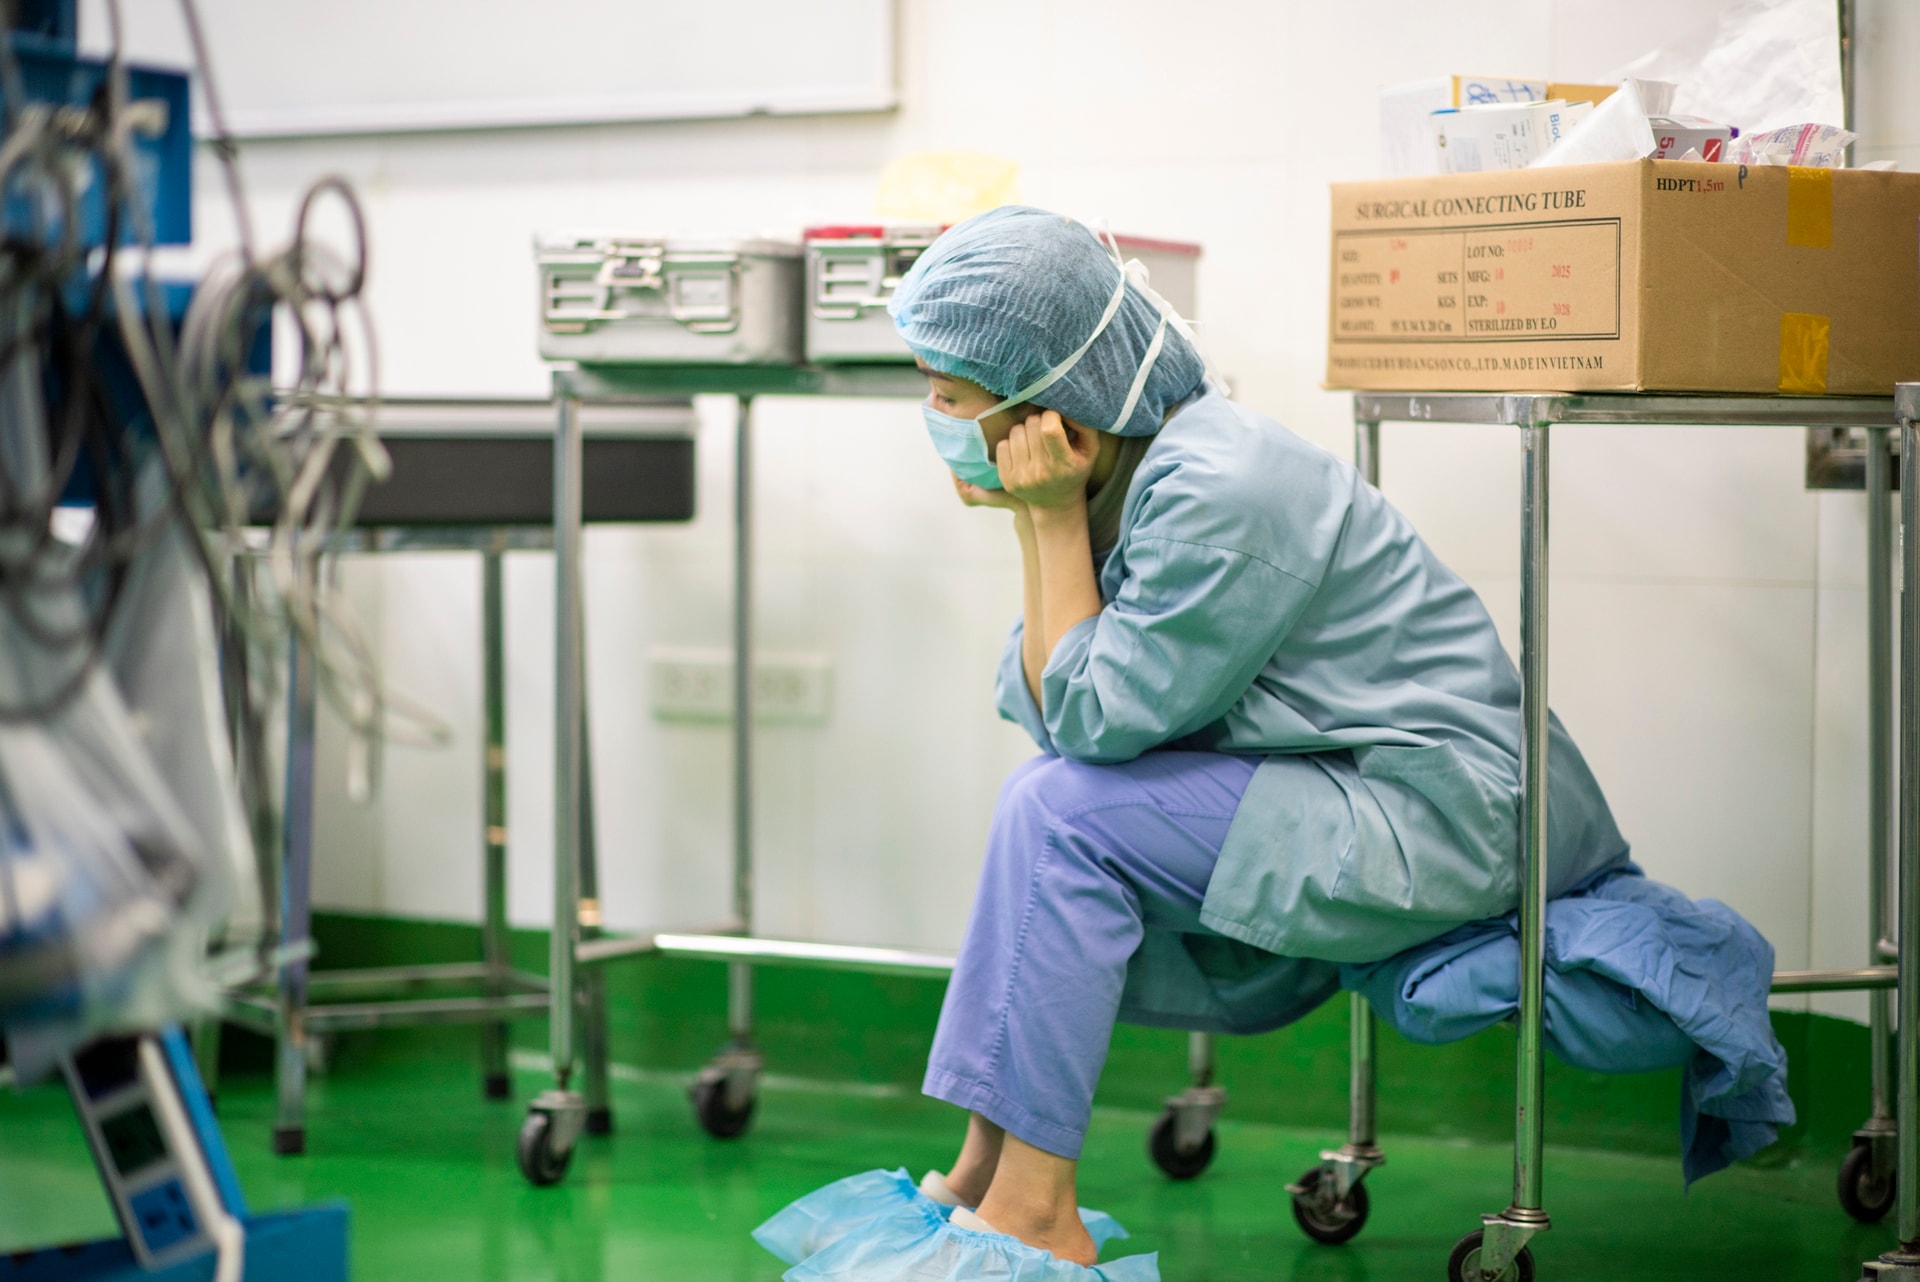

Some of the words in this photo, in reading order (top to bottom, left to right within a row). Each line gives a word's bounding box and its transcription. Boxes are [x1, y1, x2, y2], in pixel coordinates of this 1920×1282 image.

[1356, 200, 1428, 219] SURGICAL
[1433, 193, 1537, 217] CONNECTING
[1541, 189, 1586, 209] TUBE
[1467, 246, 1485, 259] LOT
[1487, 244, 1505, 258] NO:
[1437, 271, 1458, 283] SETS
[1467, 270, 1491, 283] MFG:
[1552, 264, 1571, 279] 2025
[1467, 295, 1488, 308] EXP:
[1468, 318, 1523, 332] STERILIZED
[1526, 317, 1541, 330] BY
[1541, 317, 1557, 330] E.O
